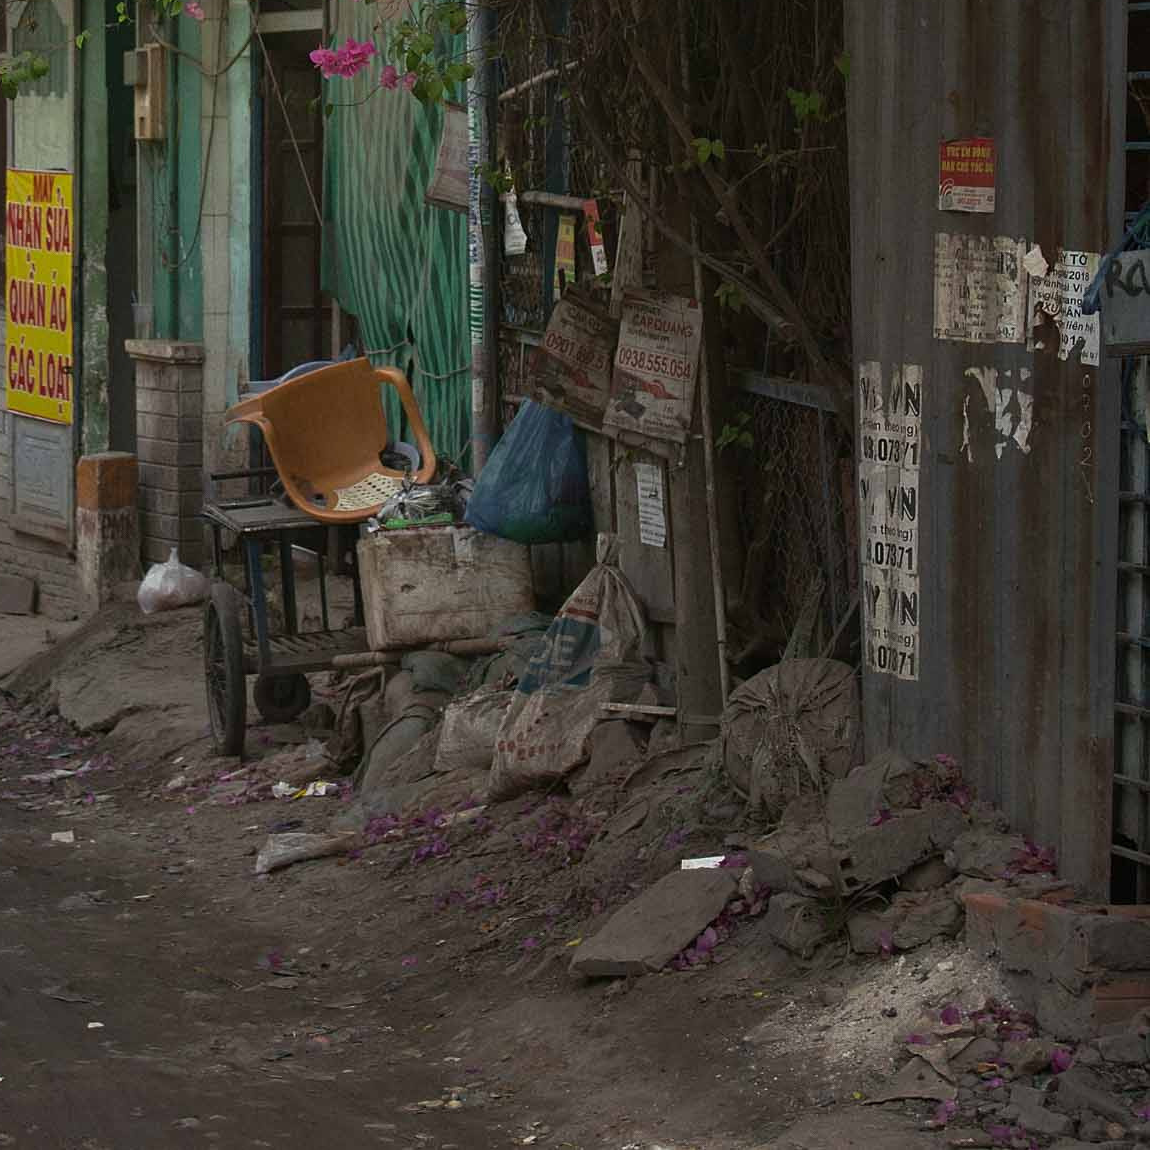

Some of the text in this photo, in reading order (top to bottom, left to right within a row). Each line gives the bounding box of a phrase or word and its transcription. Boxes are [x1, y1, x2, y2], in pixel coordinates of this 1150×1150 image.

[33, 173, 55, 203] MAY
[8, 194, 42, 261] NHẬN
[10, 262, 67, 332] QUẦN ÁO
[9, 335, 70, 414] CÁC LOẠI
